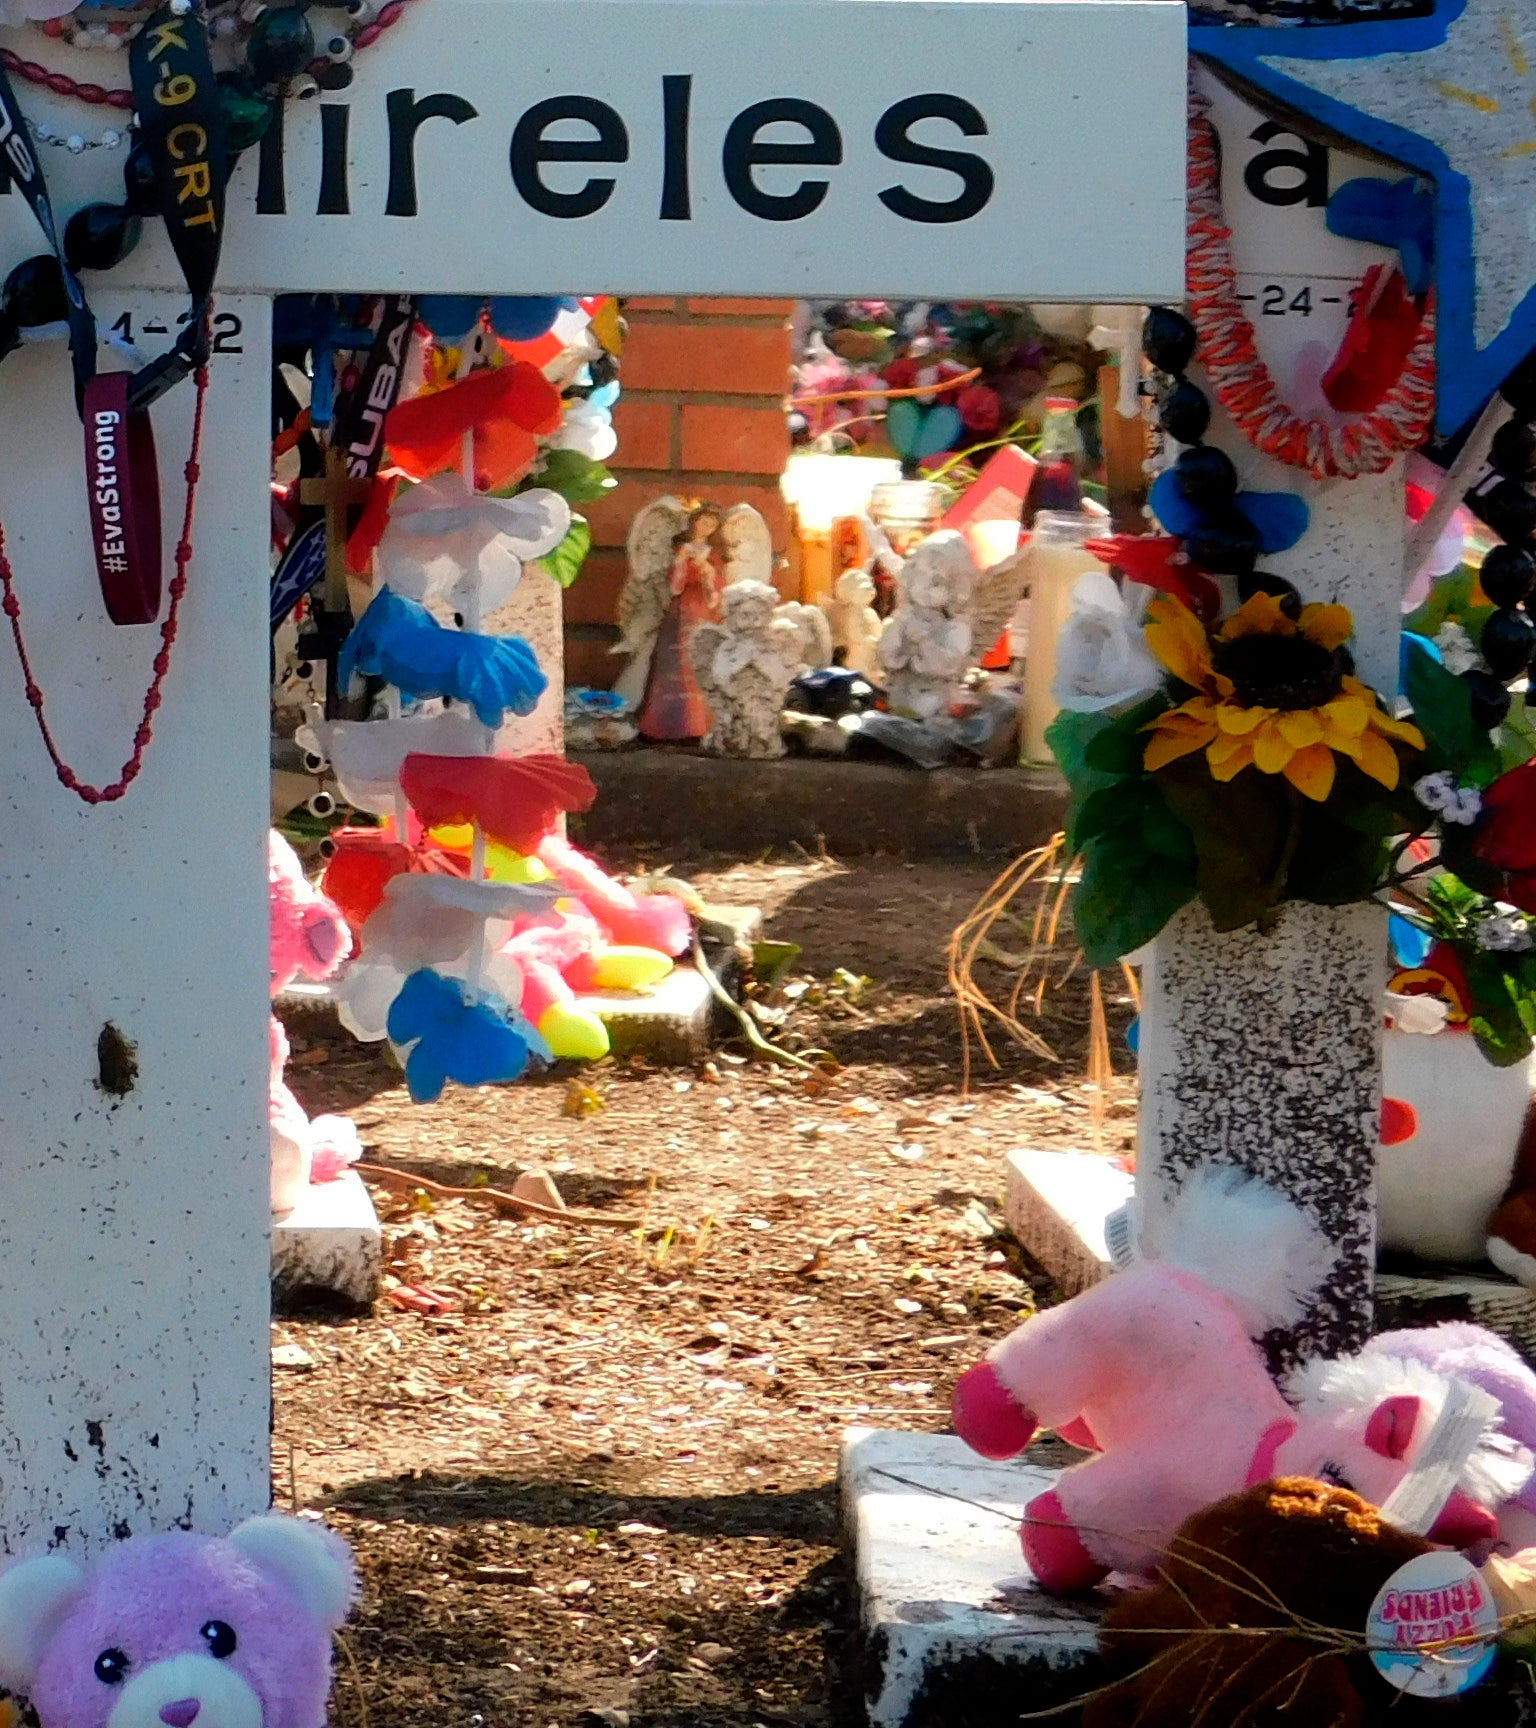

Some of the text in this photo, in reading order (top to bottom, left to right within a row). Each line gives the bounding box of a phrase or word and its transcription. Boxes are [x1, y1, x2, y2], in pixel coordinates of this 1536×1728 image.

[145, 19, 218, 235] K-9 CRT
[95, 409, 129, 575] #EvaStrong
[1381, 1575, 1484, 1624] FRIENDS
